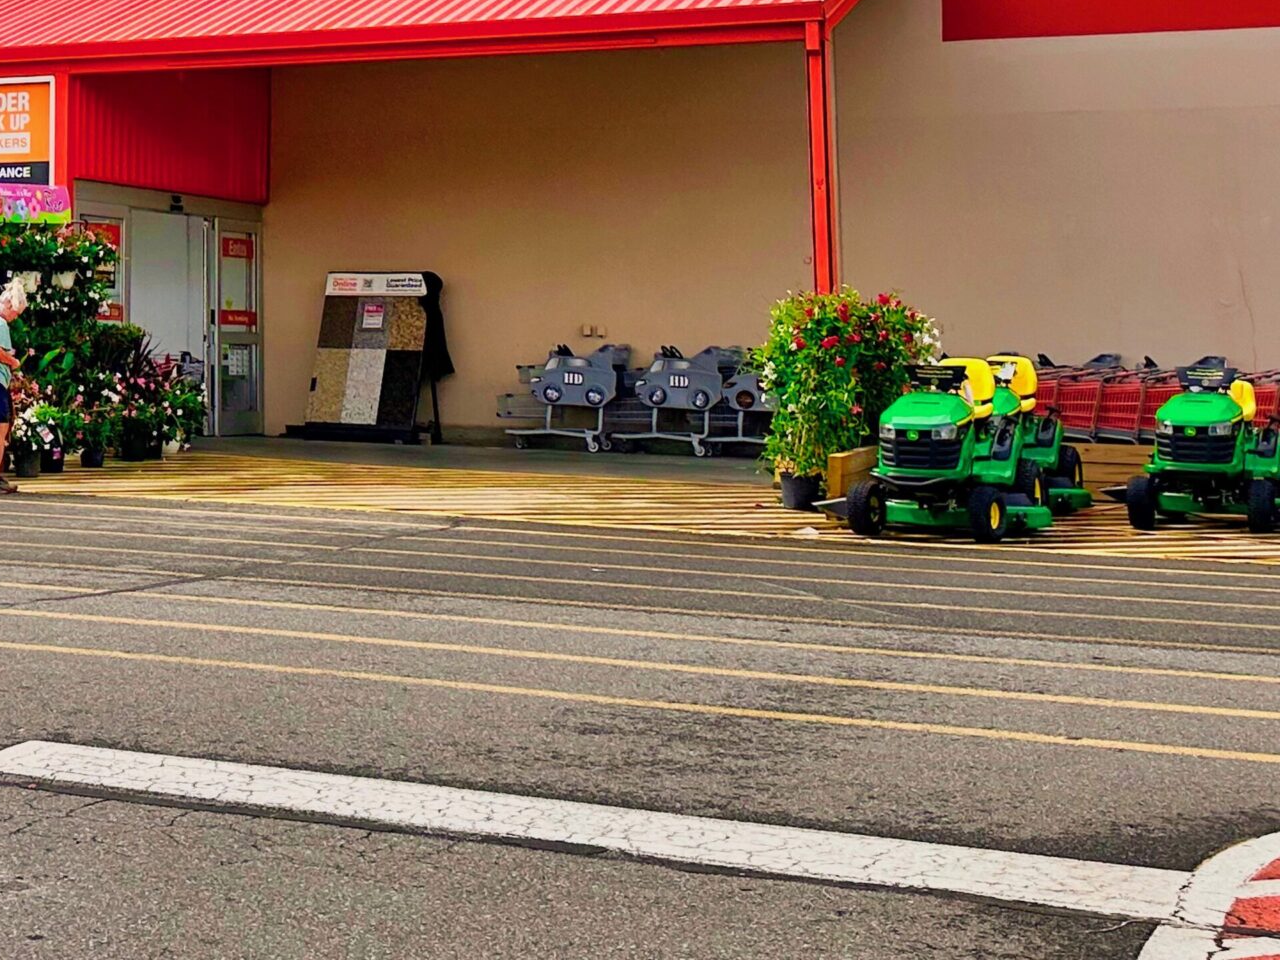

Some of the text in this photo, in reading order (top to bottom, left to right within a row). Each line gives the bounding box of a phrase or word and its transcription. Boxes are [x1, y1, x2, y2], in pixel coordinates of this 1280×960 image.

[9, 113, 30, 130] UP
[563, 372, 584, 385] HD
[669, 375, 689, 388] HD
